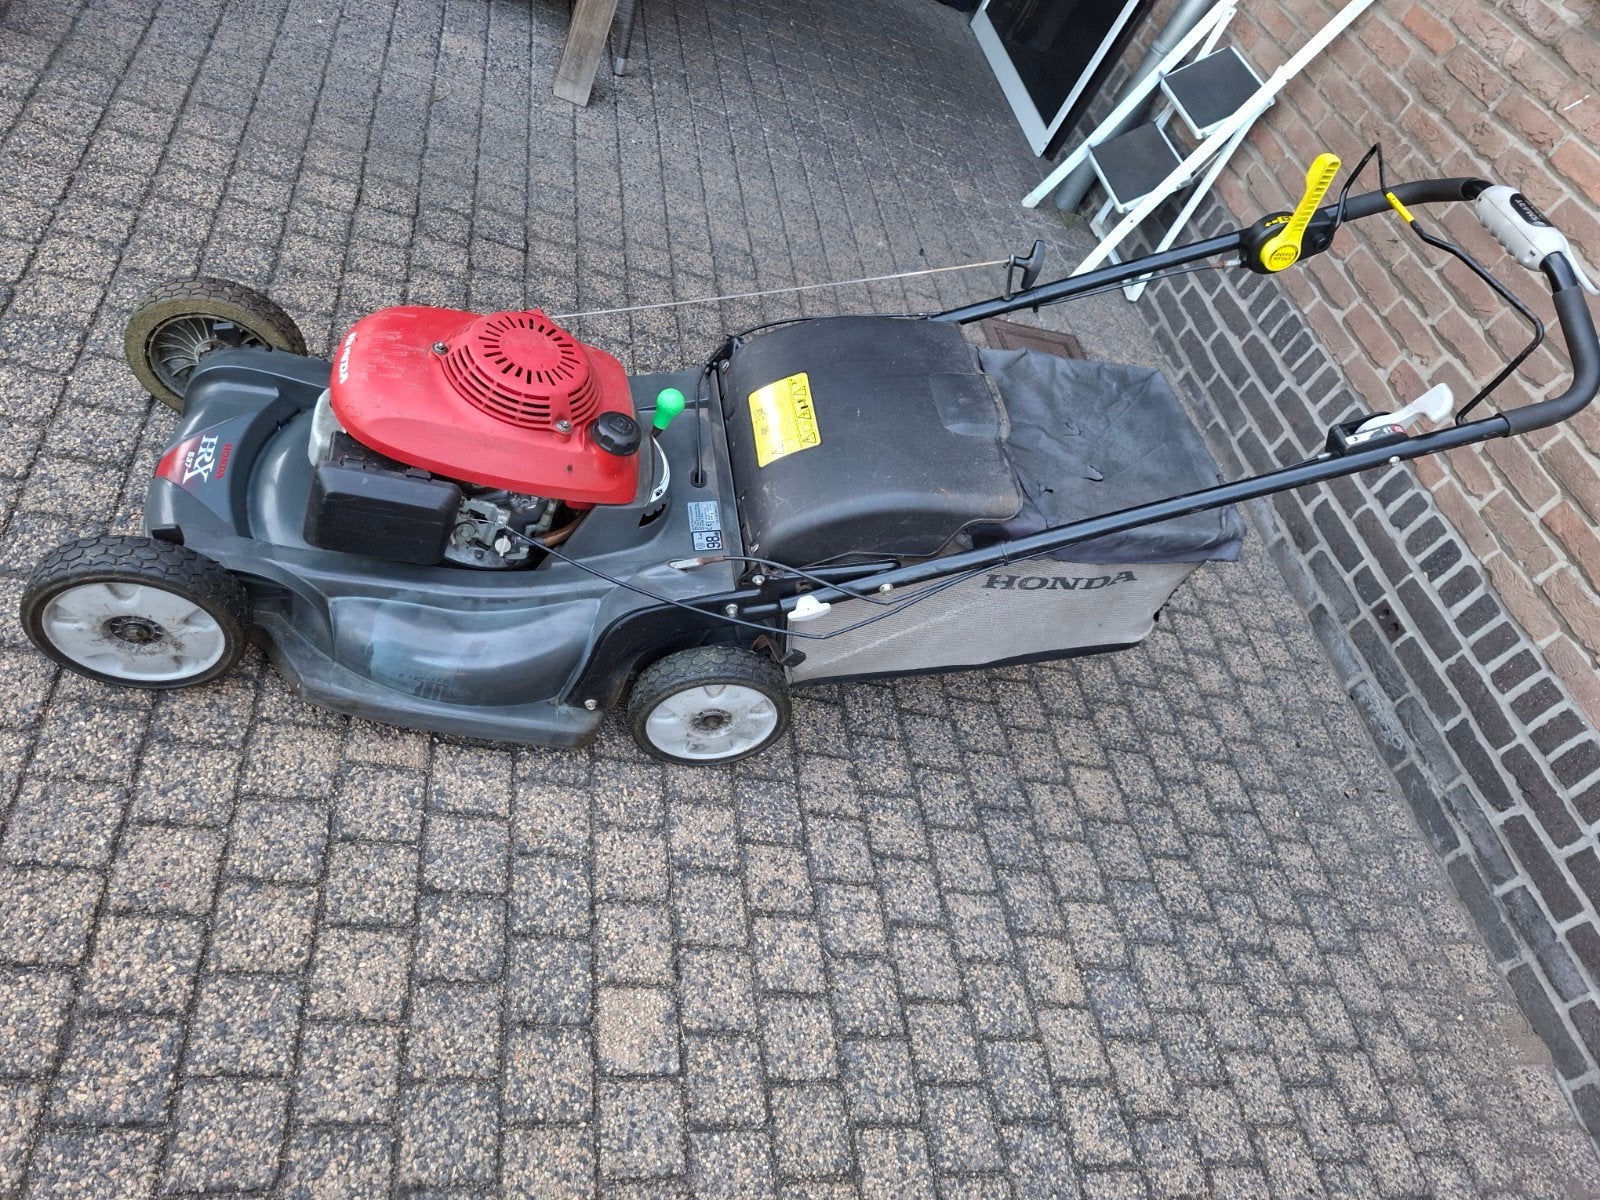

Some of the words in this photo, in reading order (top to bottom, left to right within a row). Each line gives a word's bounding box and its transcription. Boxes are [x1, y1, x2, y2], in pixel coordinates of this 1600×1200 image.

[182, 434, 219, 485] HRX
[184, 451, 195, 468] 537
[216, 443, 233, 479] HONDA
[981, 570, 1137, 590] HONDA
